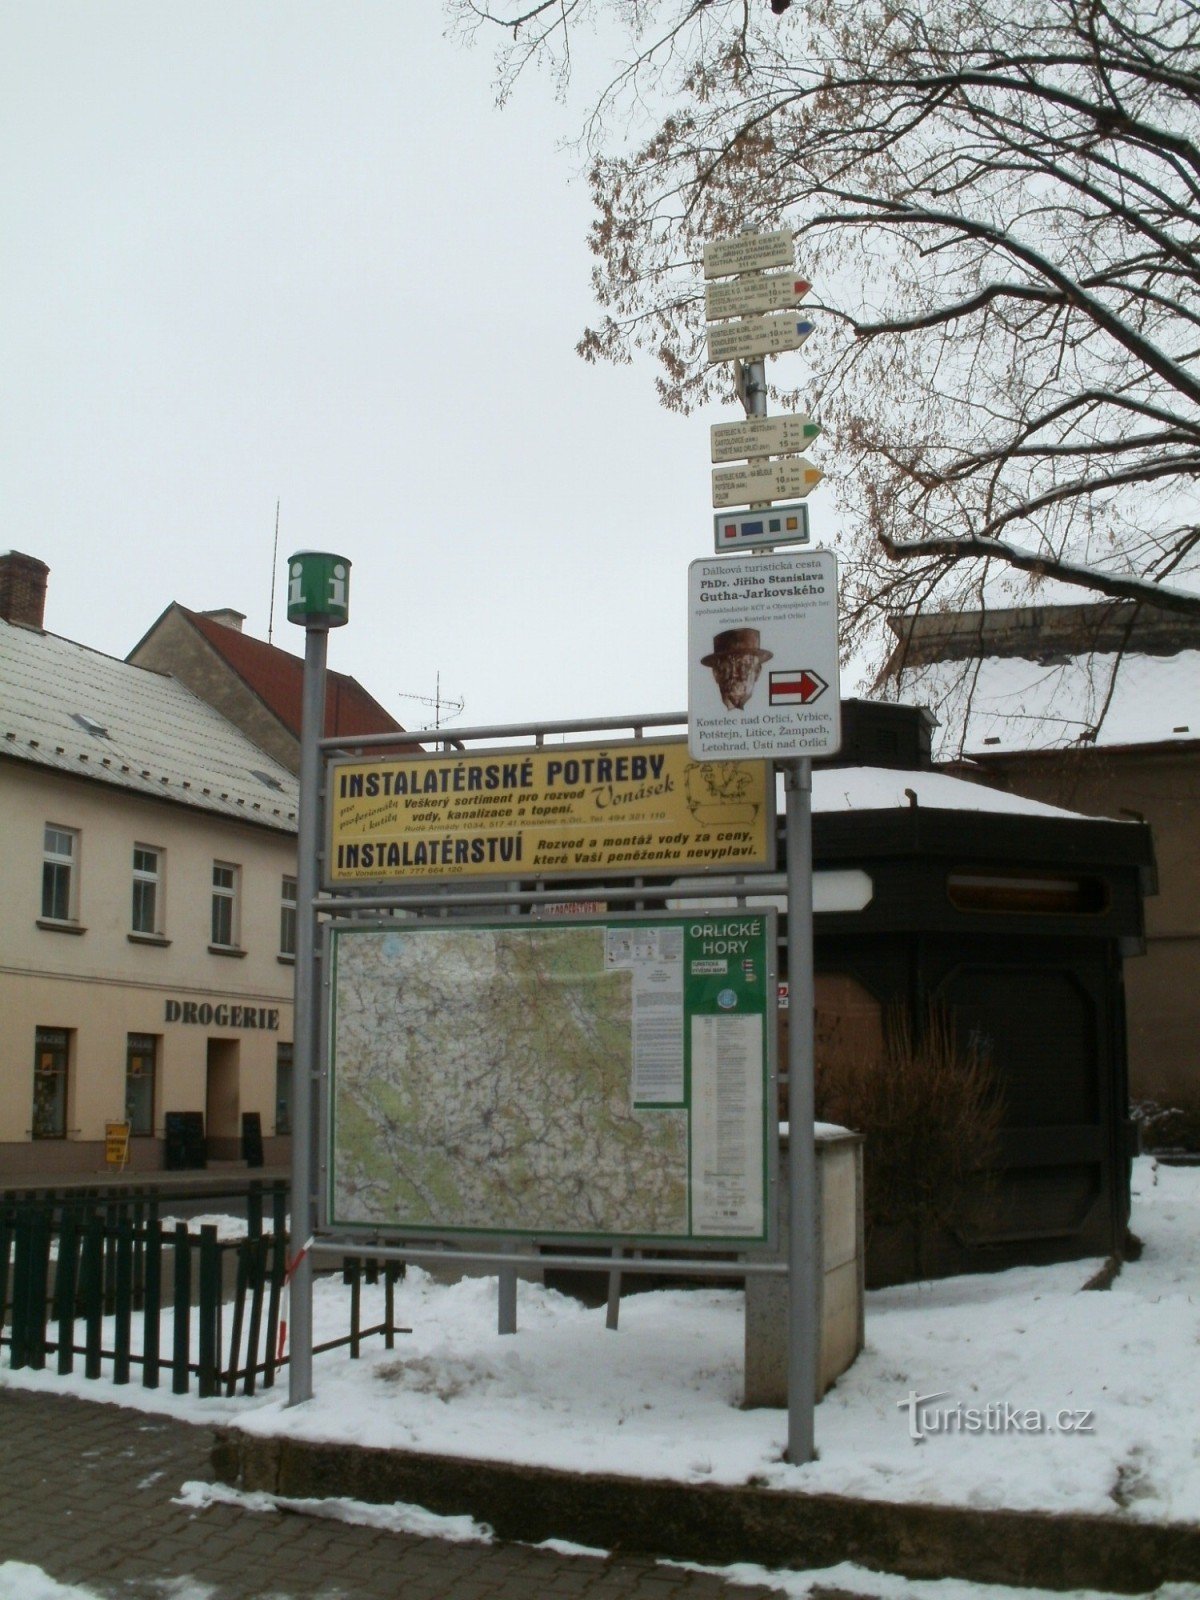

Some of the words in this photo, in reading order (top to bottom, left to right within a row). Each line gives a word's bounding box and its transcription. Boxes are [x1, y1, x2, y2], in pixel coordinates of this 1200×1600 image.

[703, 565, 742, 576] Dálková
[745, 561, 793, 574] turistická
[795, 560, 822, 569] cesta
[700, 579, 730, 589] PhDr.
[733, 576, 766, 588] Jiřího
[768, 573, 824, 585] Stanislava
[699, 584, 825, 603] Gutha-Jarkovského
[696, 716, 738, 728] Kostelec
[740, 715, 760, 726] nad
[762, 712, 793, 725] Orlicí,
[796, 710, 833, 723] Vrbice,
[745, 725, 776, 738] Litice,
[778, 722, 830, 736] Žampach,
[776, 736, 796, 748] nad
[799, 734, 827, 748] Orlicí
[340, 758, 534, 798] INSTALATÉRSKÉ
[547, 752, 665, 786] POTŘEBY
[404, 796, 450, 809] Veškerý
[454, 793, 515, 806] sortiment
[517, 792, 538, 804] pro
[543, 789, 585, 801] rozvod
[591, 772, 676, 810] Vonásek
[412, 810, 441, 823] vody,
[447, 807, 513, 820] kanalizace
[518, 808, 526, 816] a
[531, 803, 574, 817] topení.
[463, 821, 486, 830] 1034,
[489, 820, 507, 828] 517
[337, 831, 523, 869] INSTALATÉRSTVÍ
[537, 838, 583, 851] Rozvod
[589, 839, 597, 848] a
[603, 833, 653, 847] montáž
[658, 832, 690, 846] vody
[695, 833, 711, 842] za
[533, 852, 568, 865] které
[607, 846, 681, 864] peněženku
[410, 867, 425, 875] 777
[690, 920, 761, 938] ORLICKÉ
[703, 940, 749, 955] HORY
[165, 999, 279, 1031] DROGERIE
